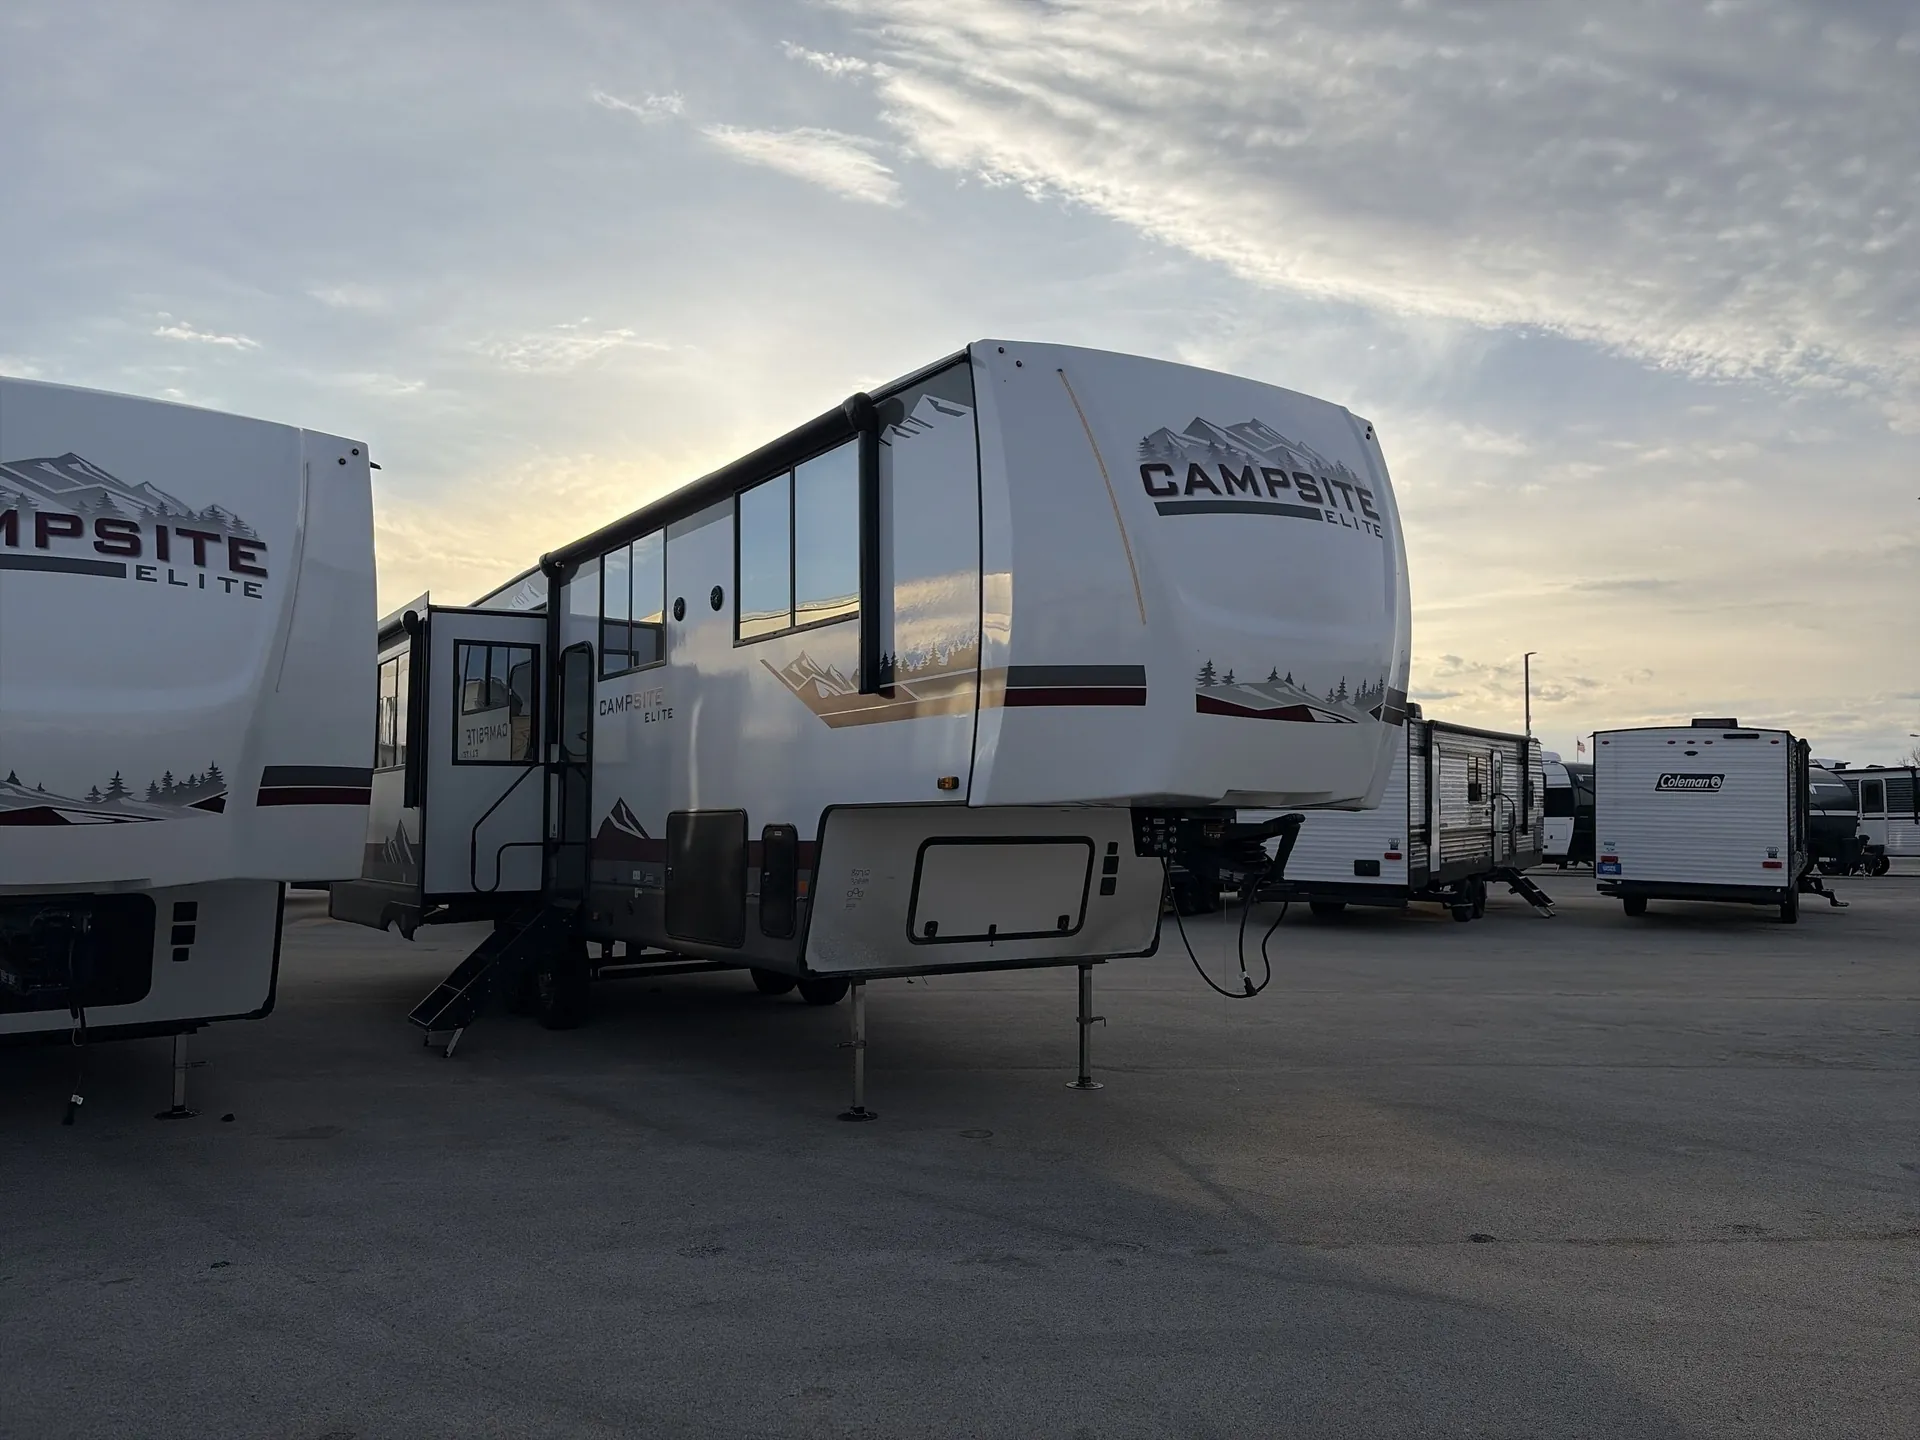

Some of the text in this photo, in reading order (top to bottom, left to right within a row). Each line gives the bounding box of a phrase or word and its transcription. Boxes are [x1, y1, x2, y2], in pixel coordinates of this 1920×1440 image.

[1139, 462, 1381, 521] CAMPSITE
[1325, 509, 1384, 538] ELITE
[136, 564, 262, 600] ELITE
[600, 689, 662, 716] CAMPSITE
[644, 708, 674, 723] ELITE
[1660, 774, 1710, 788] Coleman
